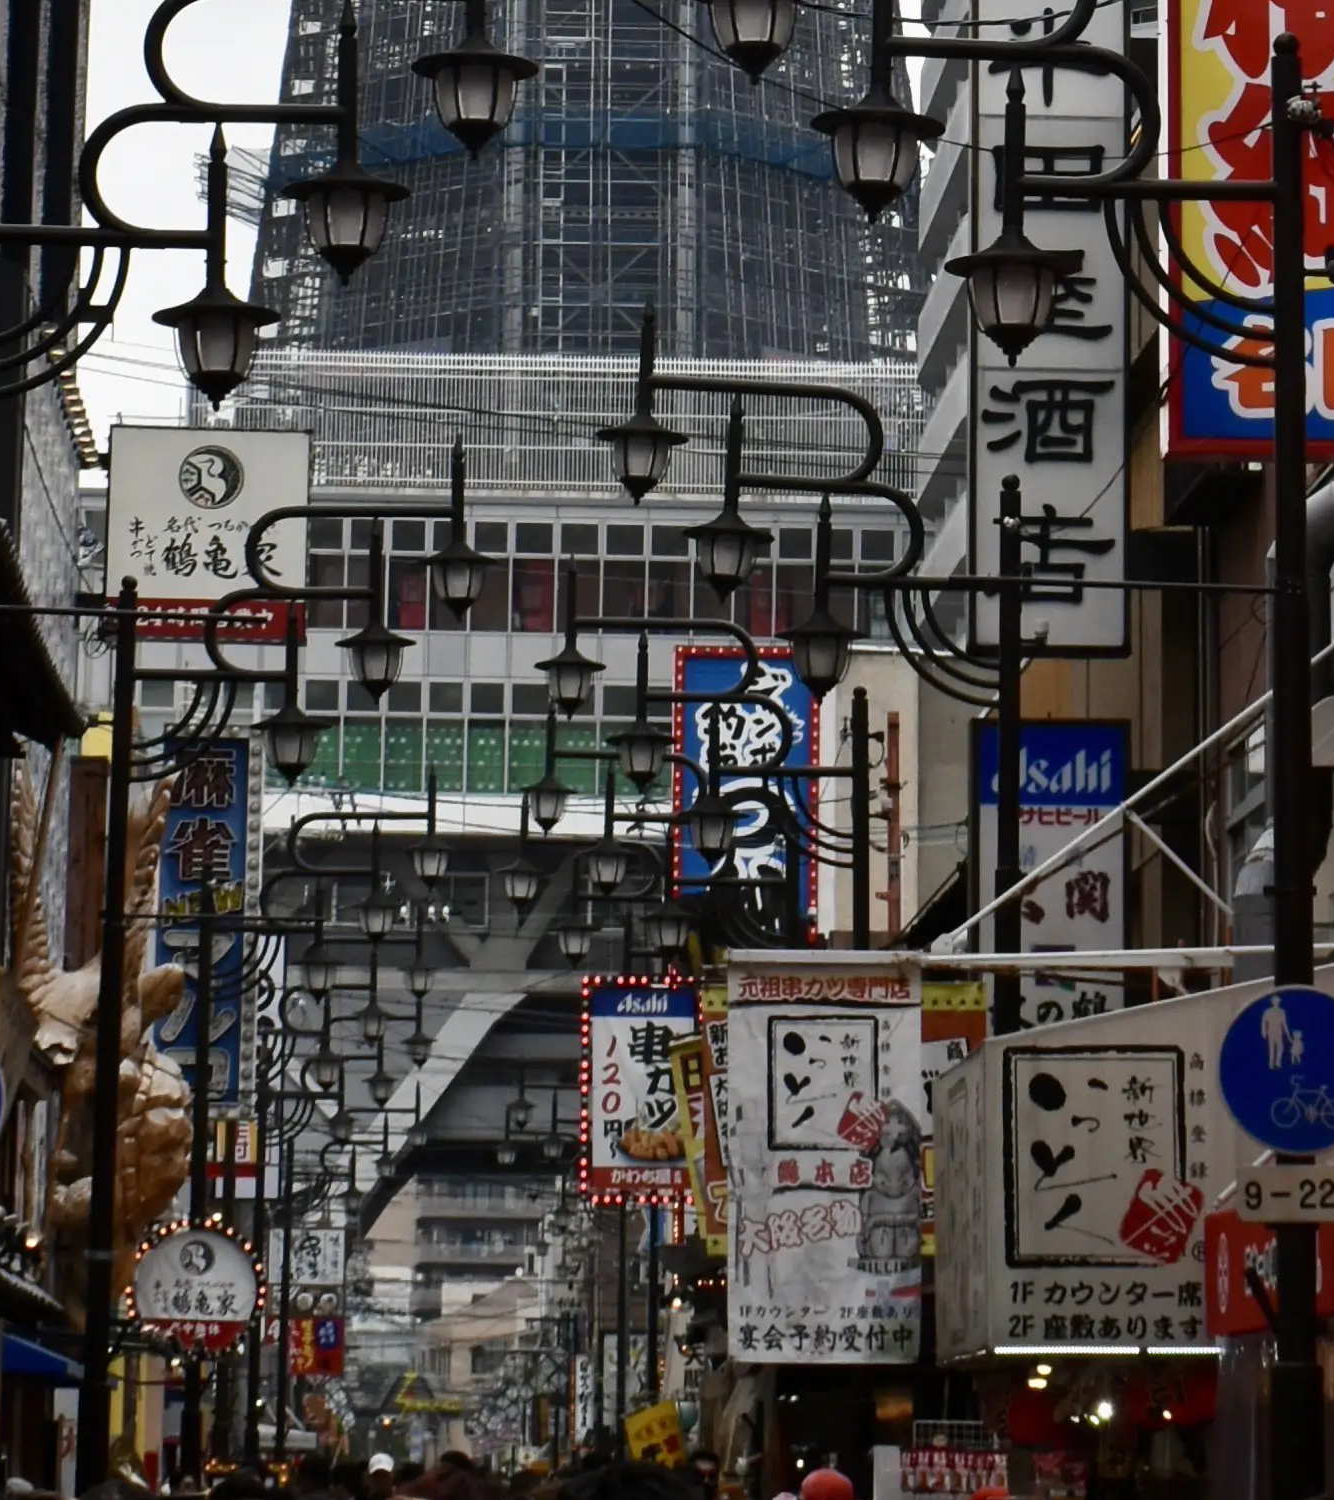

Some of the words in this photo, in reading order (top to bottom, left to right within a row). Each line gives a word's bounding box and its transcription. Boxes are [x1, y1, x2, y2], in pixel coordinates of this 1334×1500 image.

[1018, 806, 1105, 826] サヒビール
[739, 976, 912, 1001] 元祖串カツ専門店
[617, 992, 669, 1014] Asahi
[1010, 1281, 1035, 1305] 1F
[1043, 1281, 1203, 1308] カウンター席
[739, 1323, 915, 1353] 宴会予約受付中
[1009, 1315, 1036, 1340] 2F
[1043, 1314, 1204, 1341] 座敷あります
